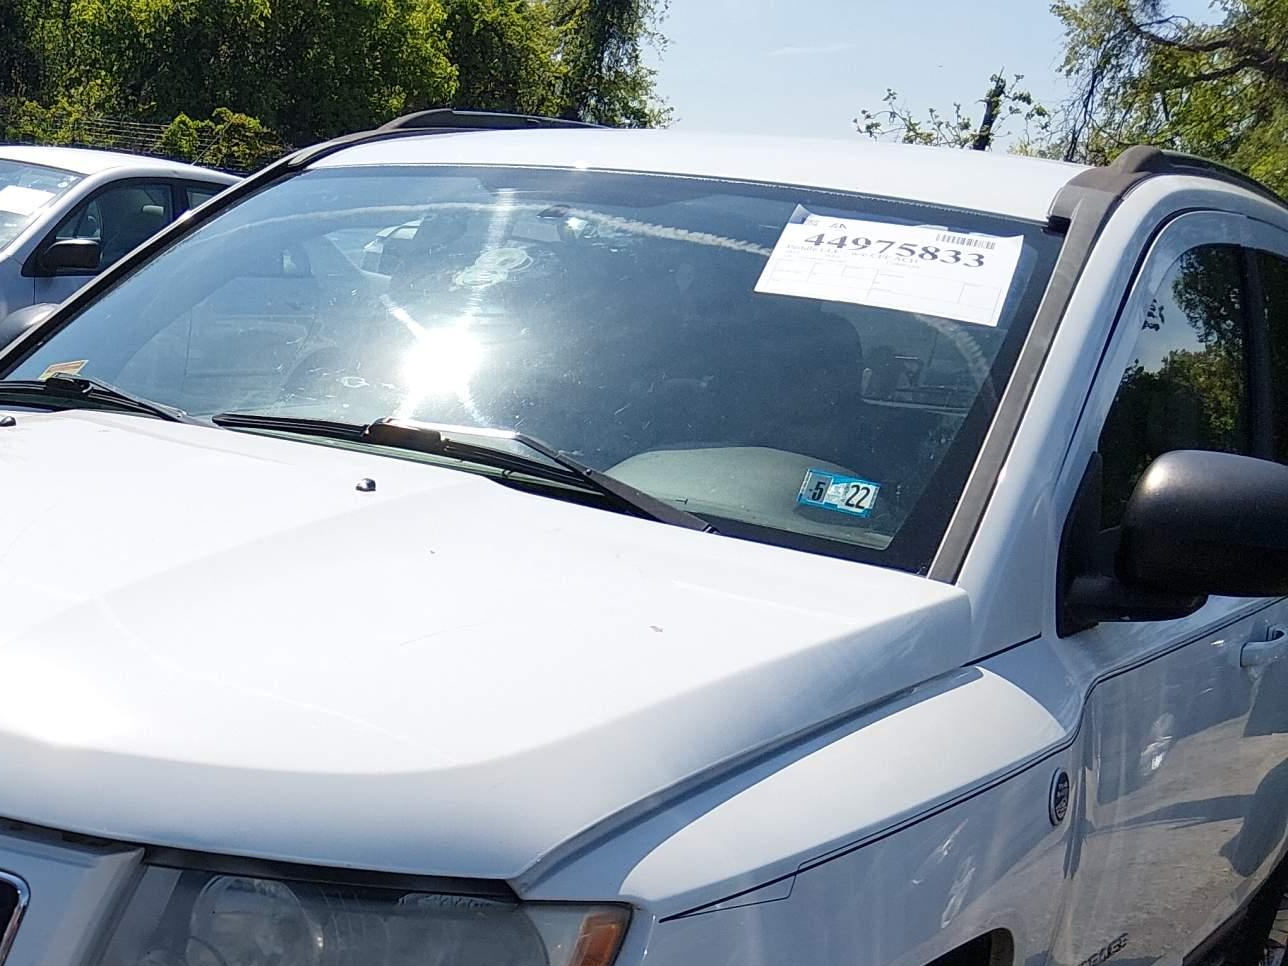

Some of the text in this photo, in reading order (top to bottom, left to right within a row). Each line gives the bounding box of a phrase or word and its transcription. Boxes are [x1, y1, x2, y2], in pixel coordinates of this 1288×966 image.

[804, 233, 985, 268] 44975833
[811, 481, 871, 509] 5 22
